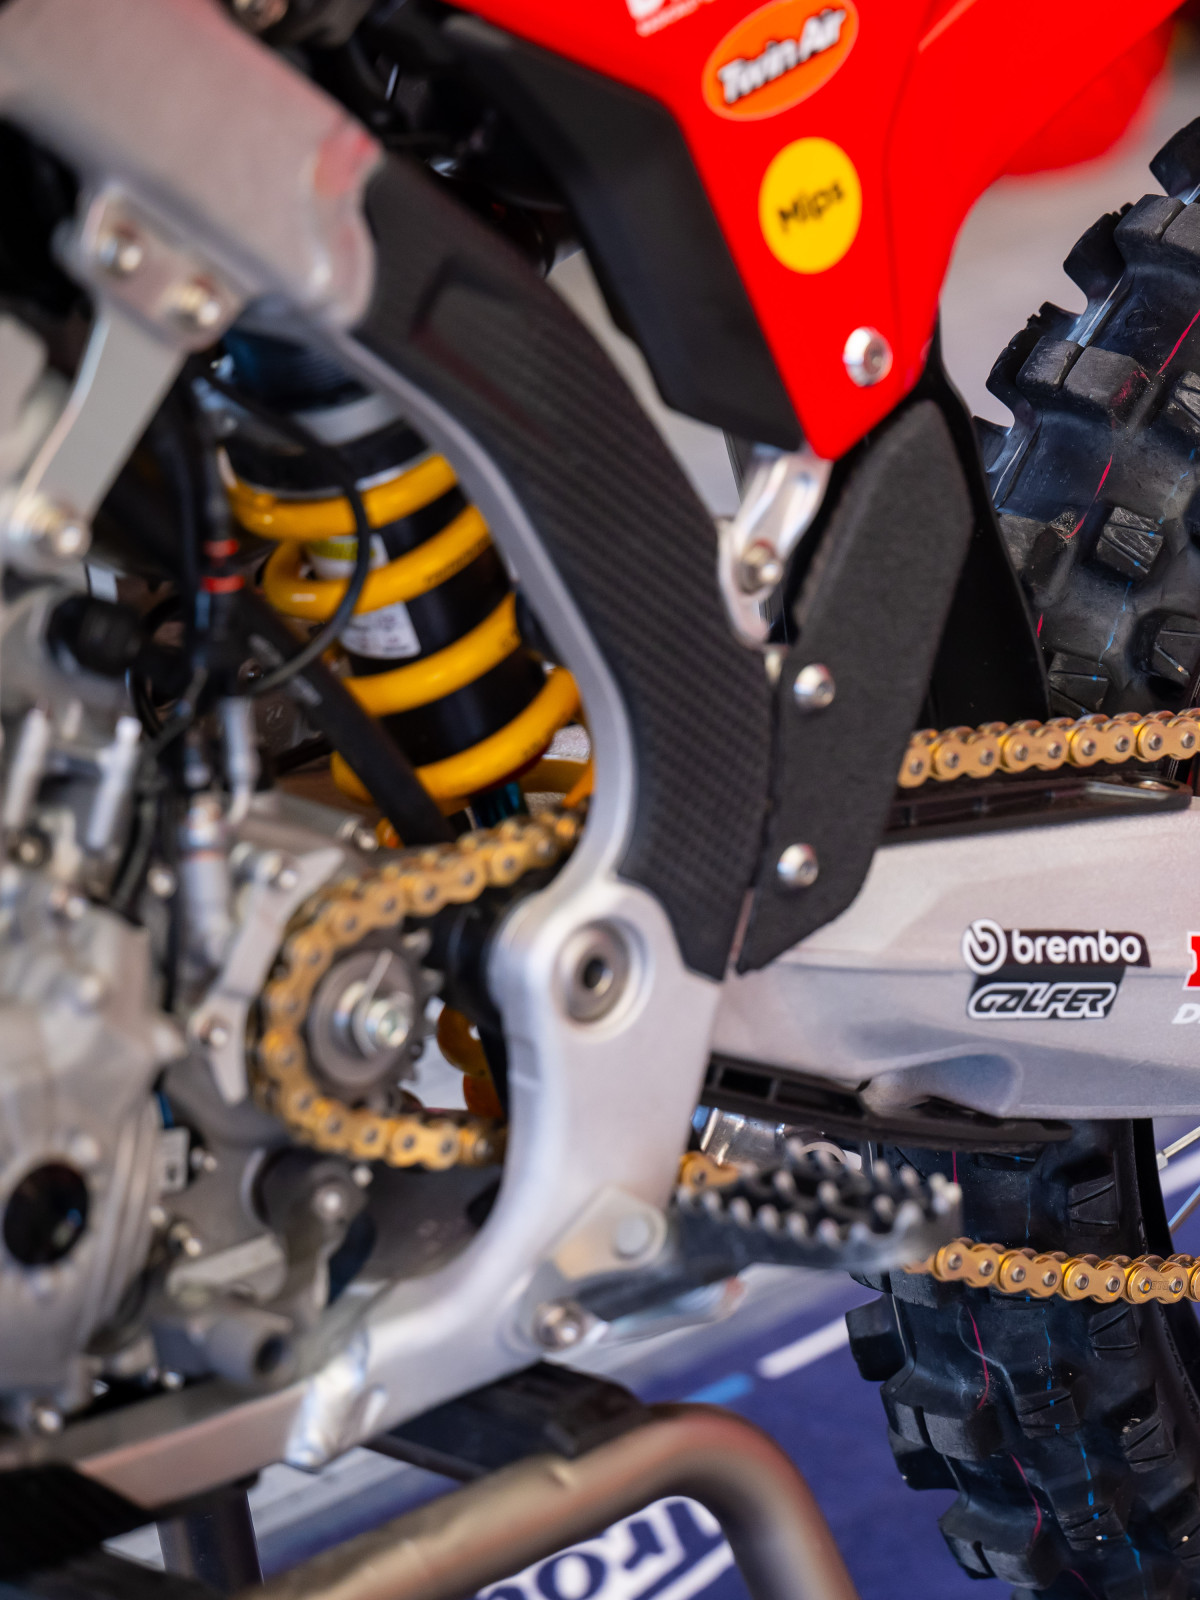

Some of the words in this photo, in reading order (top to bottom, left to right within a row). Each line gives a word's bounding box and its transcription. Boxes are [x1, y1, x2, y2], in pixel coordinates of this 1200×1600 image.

[717, 39, 799, 104] Twin
[799, 8, 847, 63] Air
[777, 181, 845, 234] Mips
[1012, 929, 1142, 964] brembo
[967, 982, 1117, 1019] GALFER
